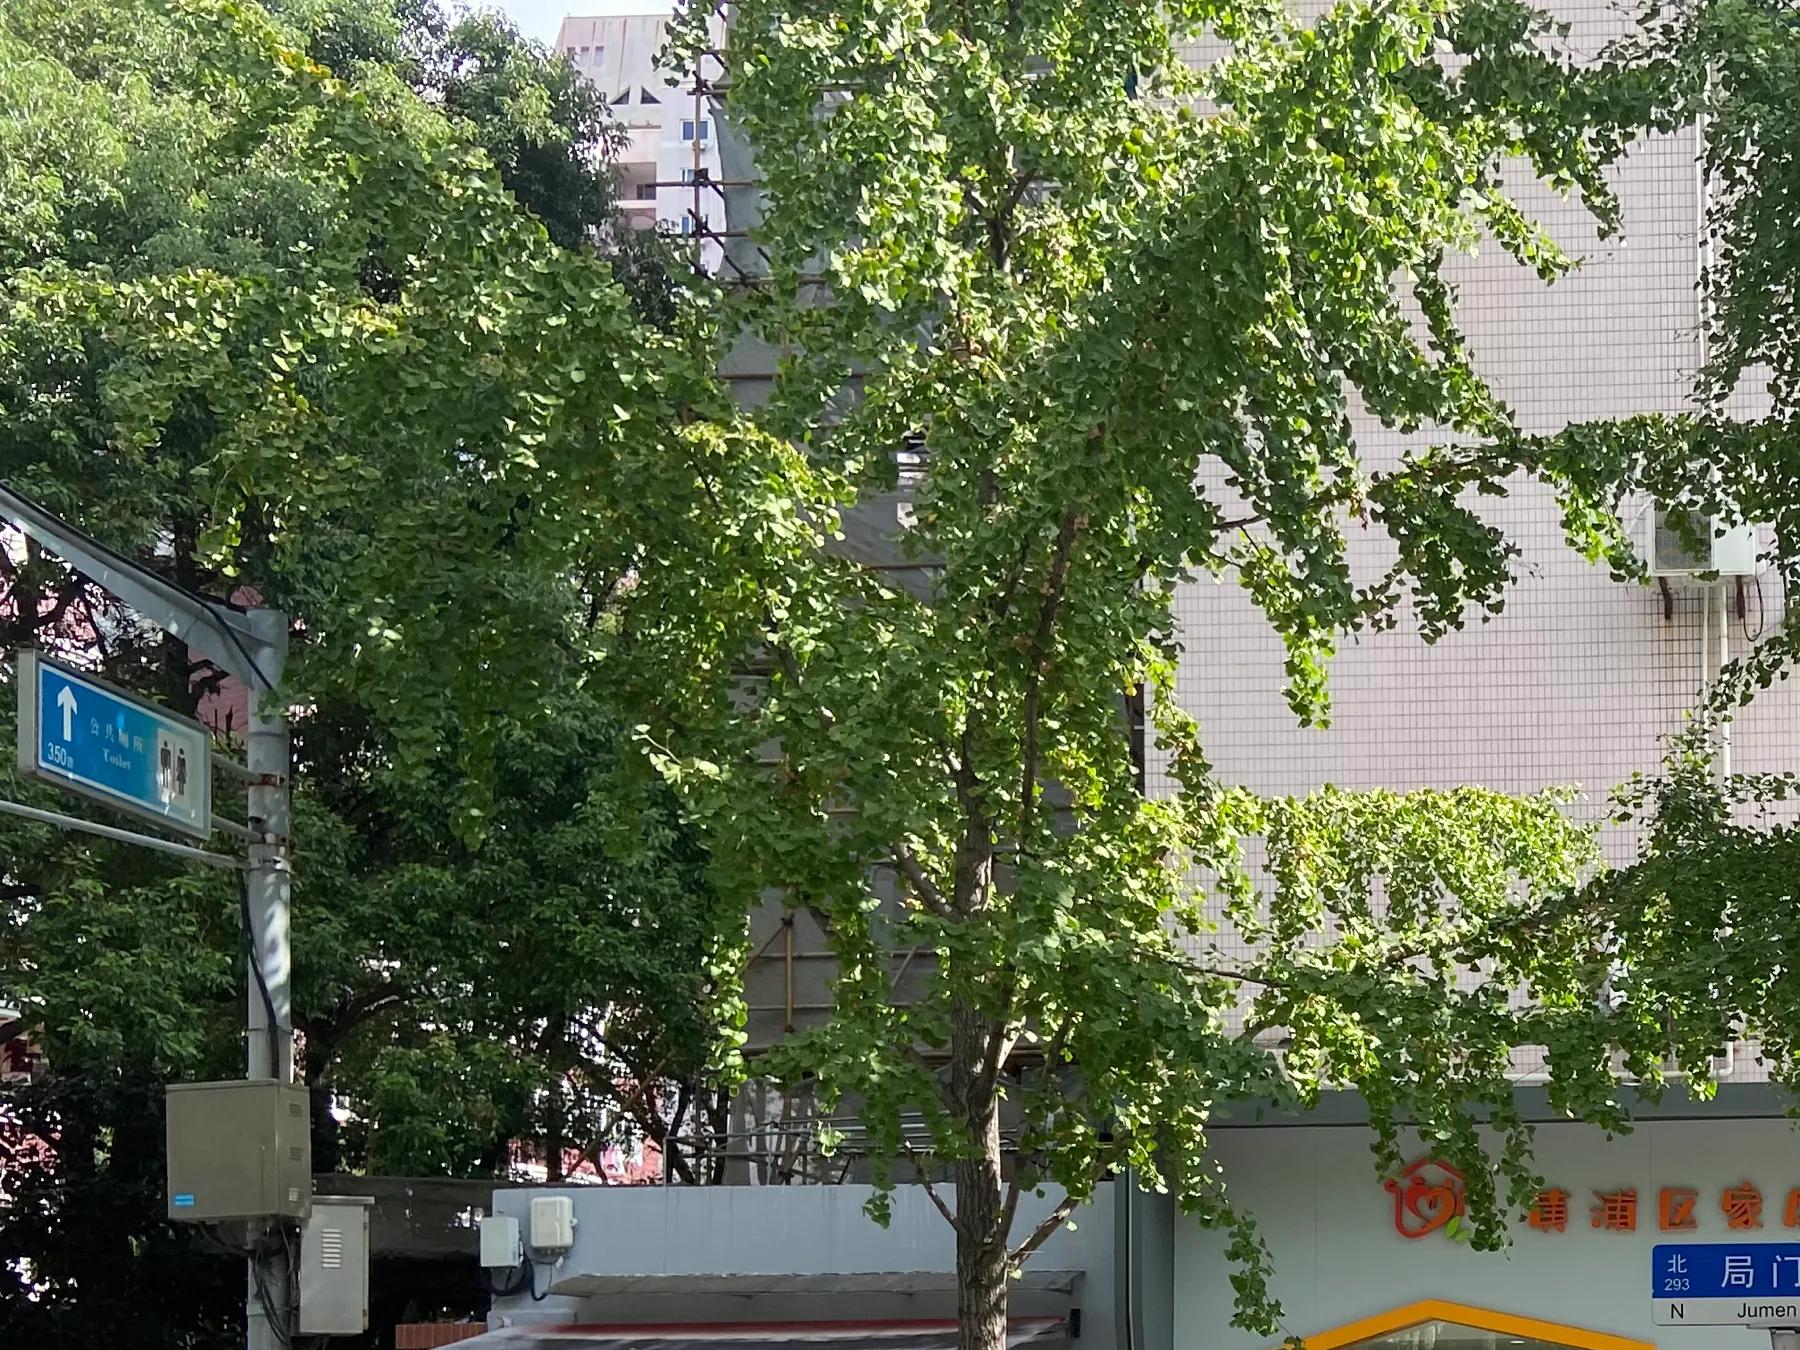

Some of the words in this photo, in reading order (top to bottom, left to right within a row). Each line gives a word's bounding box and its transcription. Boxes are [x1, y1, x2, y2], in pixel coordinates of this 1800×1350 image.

[1667, 1254, 1687, 1274] 北
[1664, 1278, 1690, 1291] 293
[1670, 1303, 1684, 1319] N
[1737, 1303, 1796, 1318] Jumen
